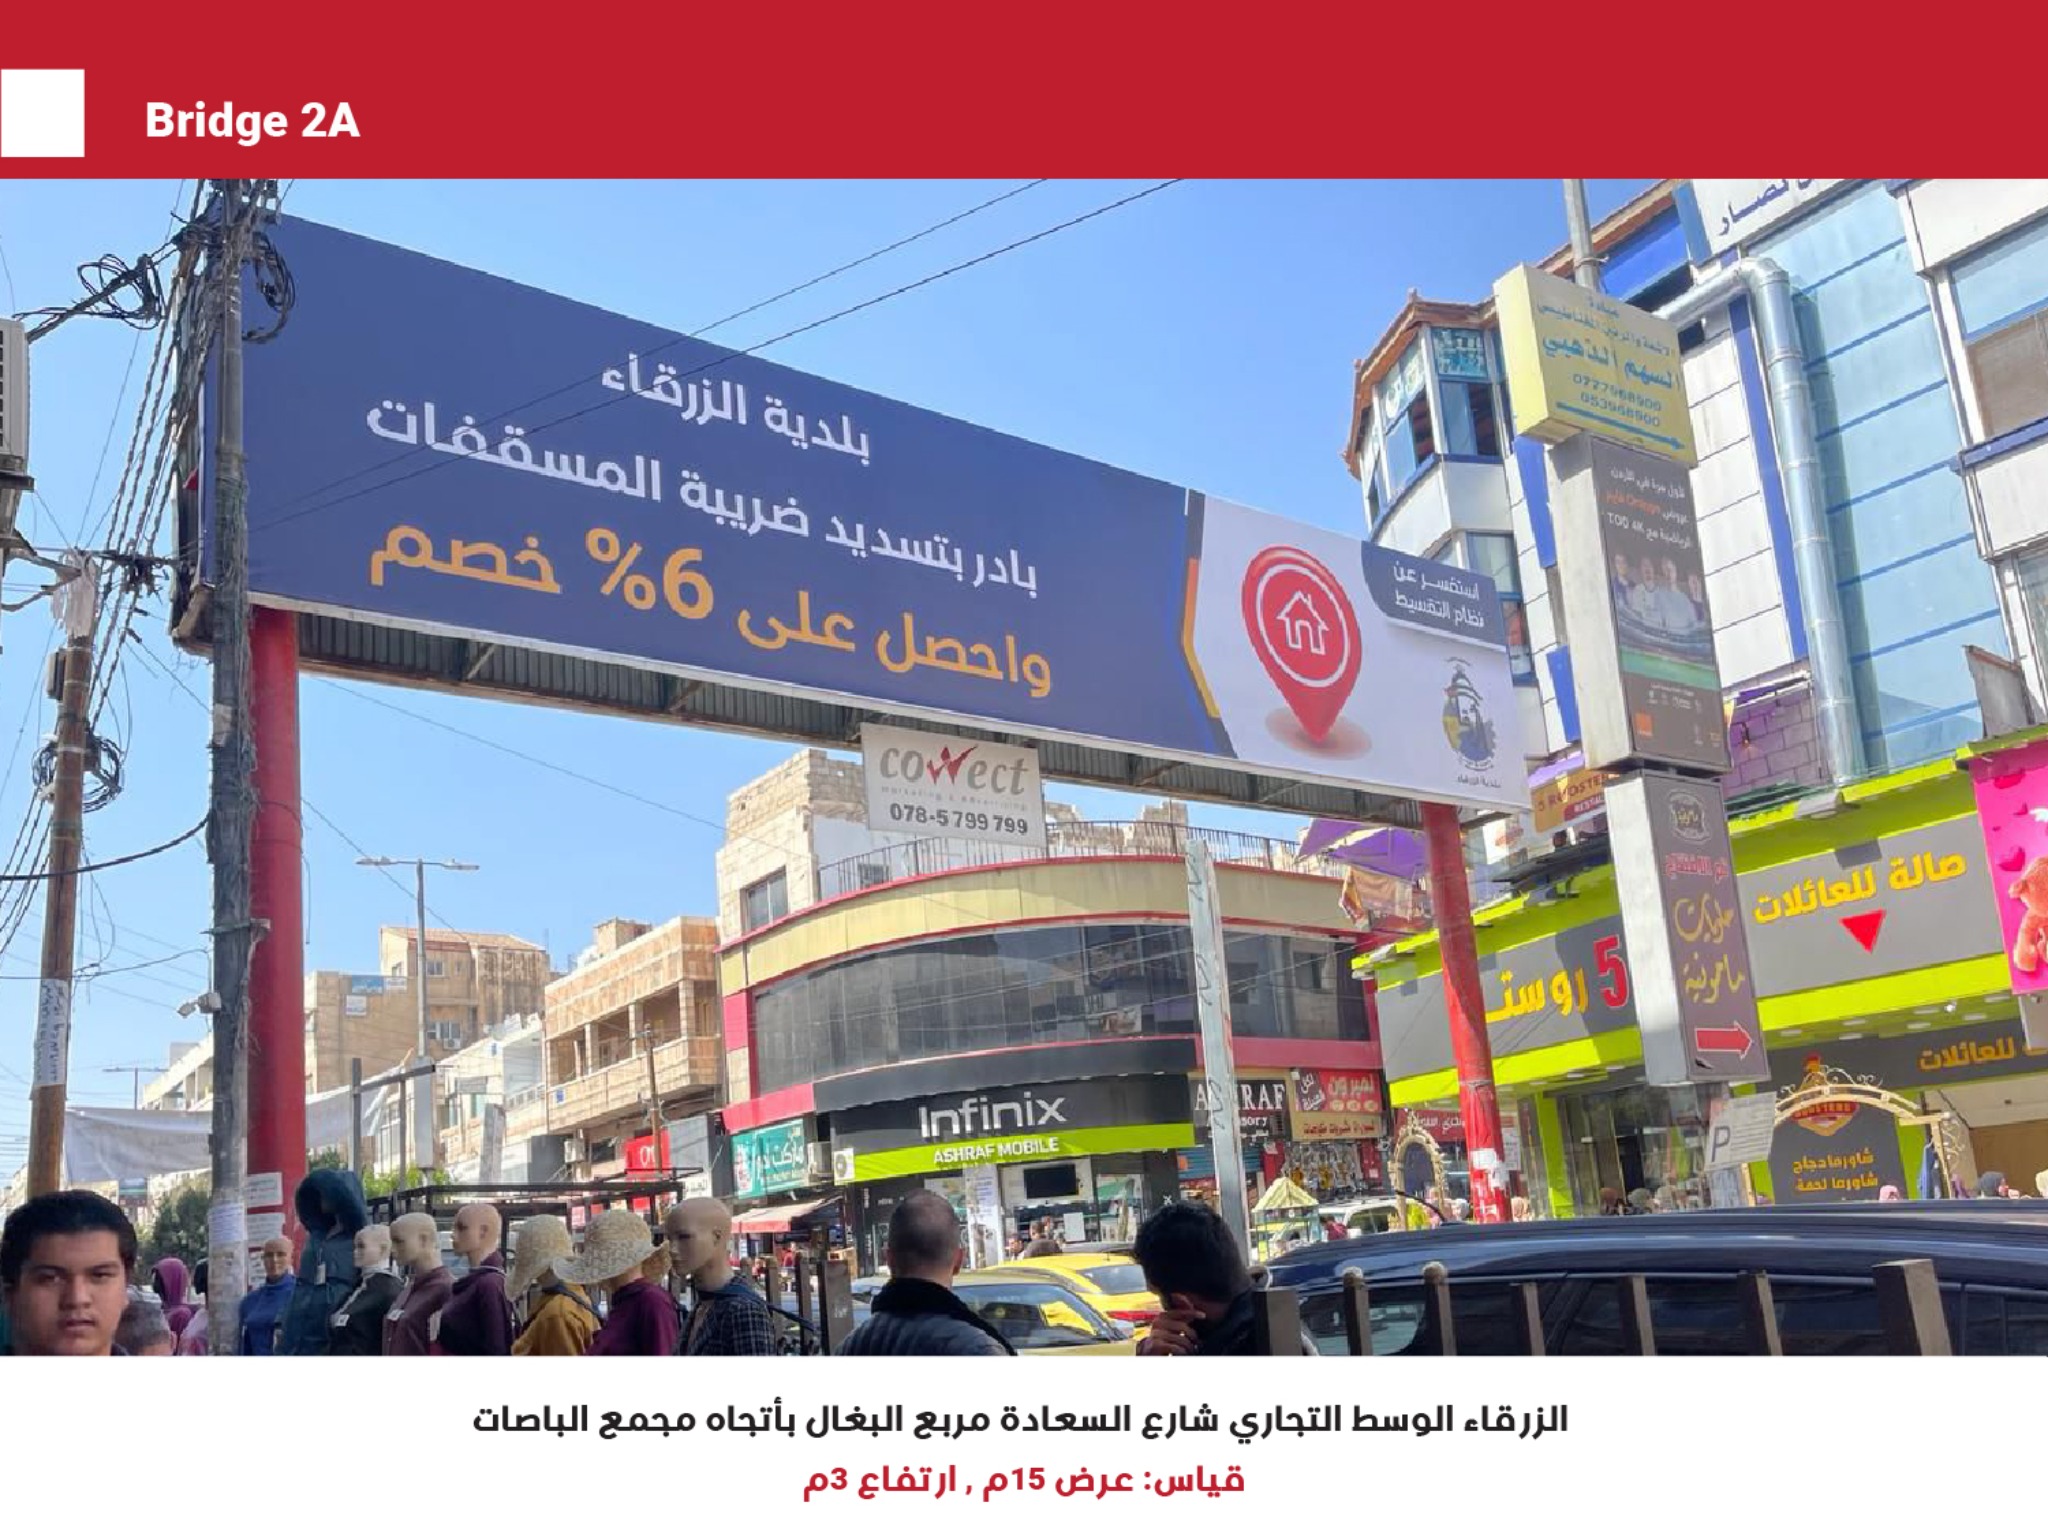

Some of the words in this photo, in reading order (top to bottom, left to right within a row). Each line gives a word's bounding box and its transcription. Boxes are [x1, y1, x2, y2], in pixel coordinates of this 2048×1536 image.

[602, 353, 747, 426] الزرقاء
[366, 400, 661, 502] المسقفات
[764, 395, 870, 467] بلدية
[680, 469, 810, 537] ضريبة
[370, 524, 563, 595] خصم
[825, 516, 964, 583] بتسديد
[973, 550, 1037, 598] بادر
[1393, 560, 1416, 583] عن
[1395, 588, 1450, 620] التقسيط
[1421, 573, 1479, 601] استفسر
[738, 590, 856, 653] على
[1454, 604, 1485, 628] نظام
[877, 611, 1051, 698] واحصل
[1753, 865, 1877, 925] للعائلات
[1888, 852, 1967, 891] صالة
[1593, 934, 1630, 1009] 5
[1917, 1036, 2015, 1071] للعائلات
[919, 1091, 1067, 1138] Infinix
[934, 1145, 996, 1164] ASHRAF
[998, 1136, 1060, 1158] MOBILE
[1711, 1125, 1731, 1163] P
